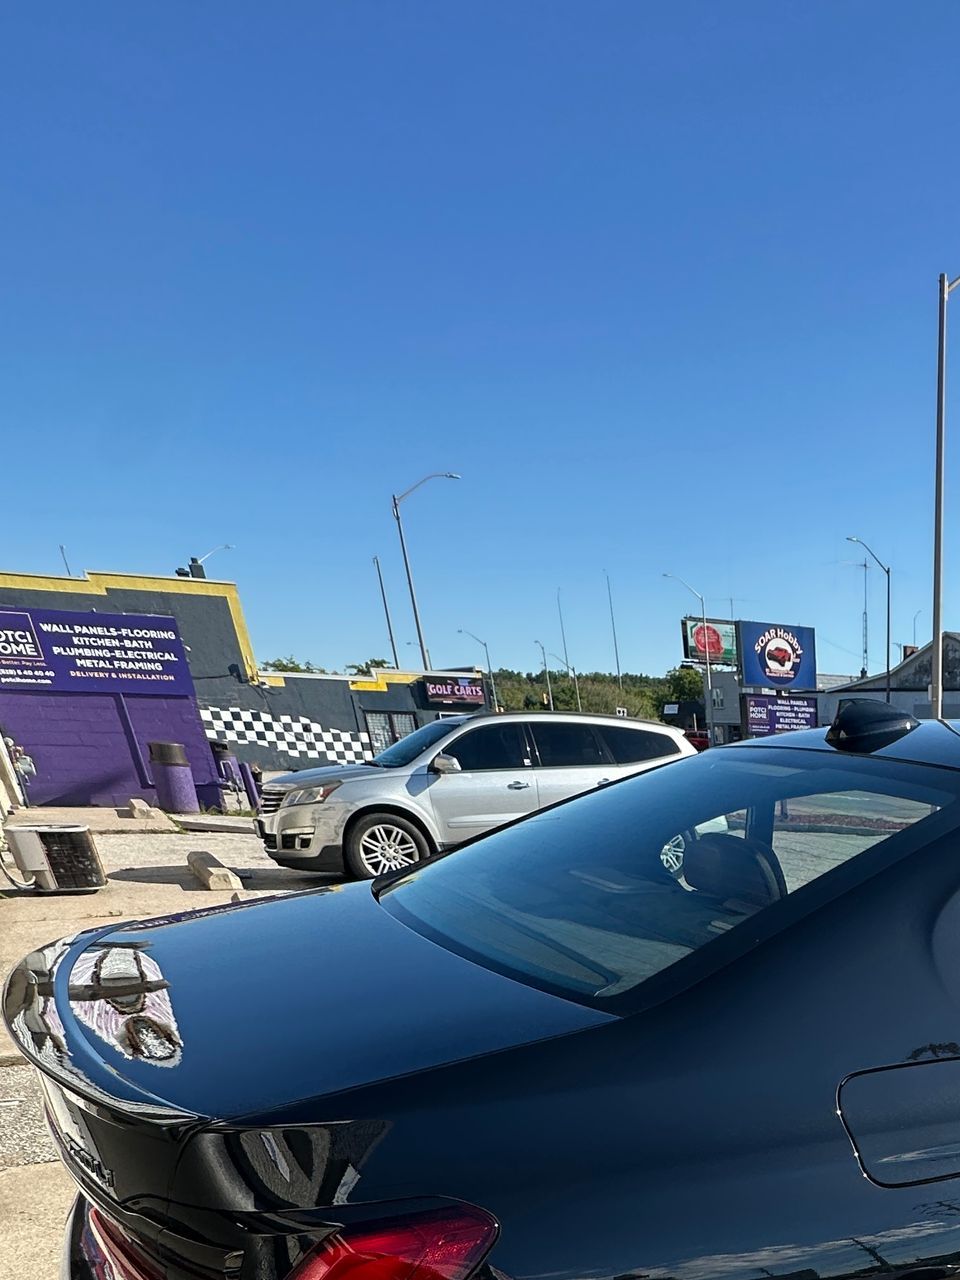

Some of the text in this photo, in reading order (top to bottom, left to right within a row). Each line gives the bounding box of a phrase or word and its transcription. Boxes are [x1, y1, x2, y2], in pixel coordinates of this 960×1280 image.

[0, 630, 33, 643] TCI
[39, 623, 176, 640] WALL PANELS-FLOORING
[72, 637, 152, 648] KITCHEN-BATH
[755, 628, 776, 653] SOAR
[777, 628, 803, 654] Hobby
[0, 643, 38, 656] OME
[52, 646, 178, 661] PLUMBING-ELECTRICAL
[76, 659, 162, 671] METAL FRAMING
[430, 684, 482, 695] GOLF CARTS
